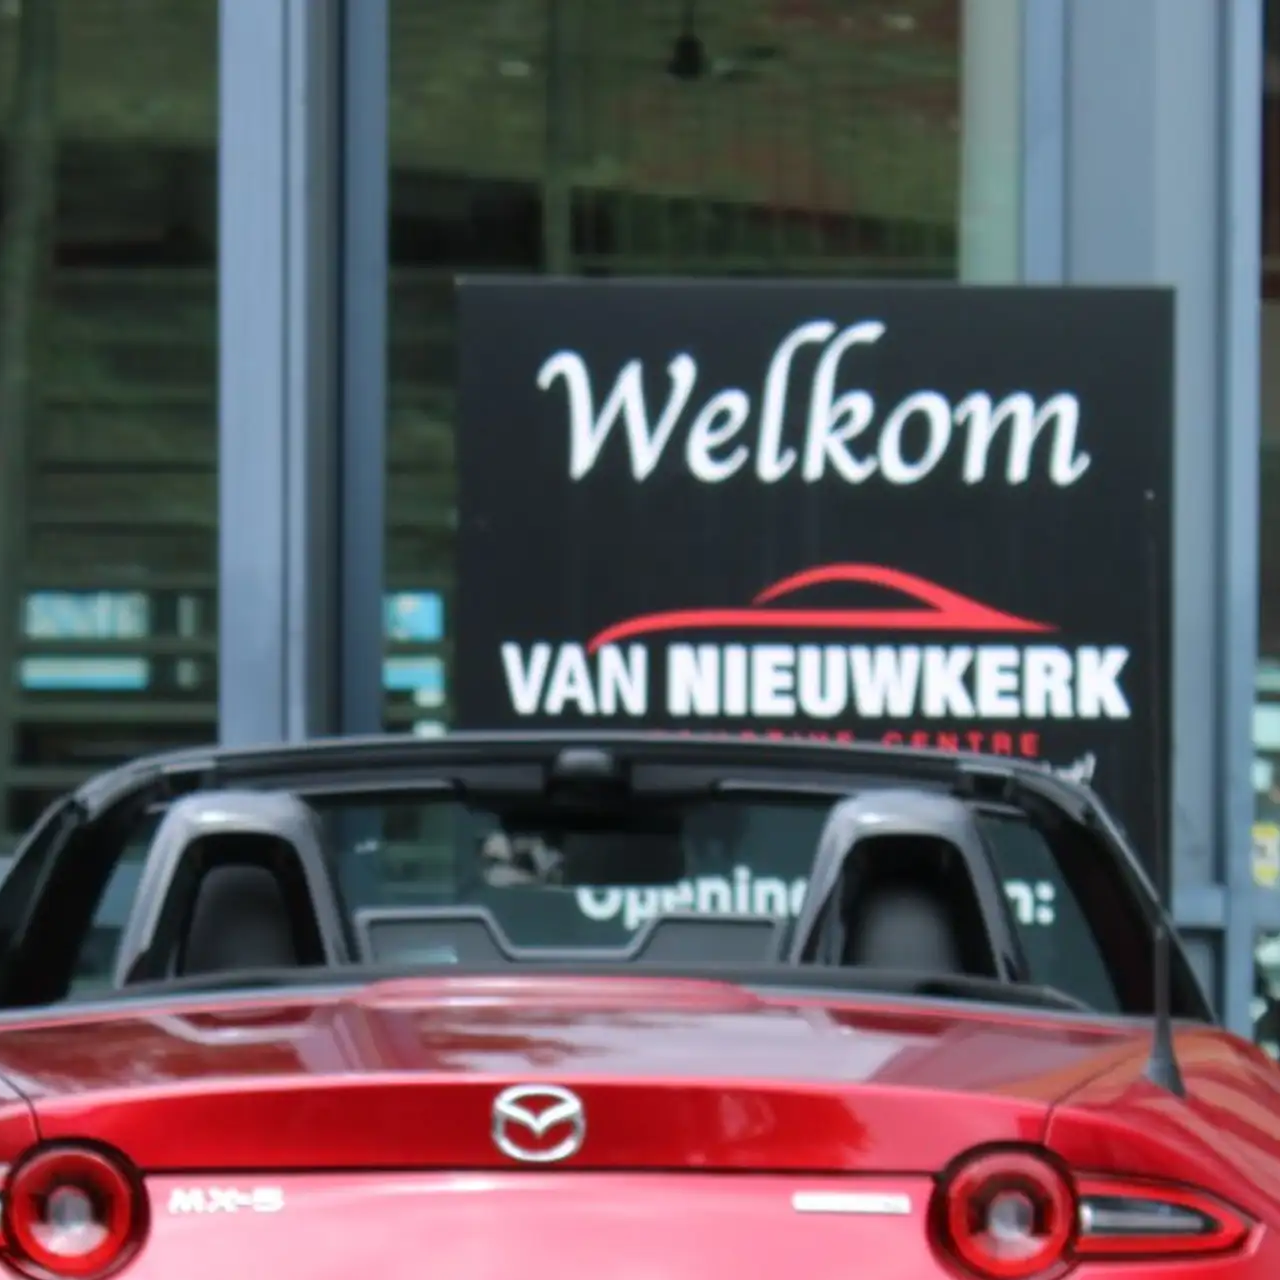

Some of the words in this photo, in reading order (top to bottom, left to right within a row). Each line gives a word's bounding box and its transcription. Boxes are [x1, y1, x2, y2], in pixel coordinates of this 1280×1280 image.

[537, 320, 1091, 486] Welkom
[501, 642, 646, 716] VAN
[667, 643, 1131, 719] NIEUWKERK
